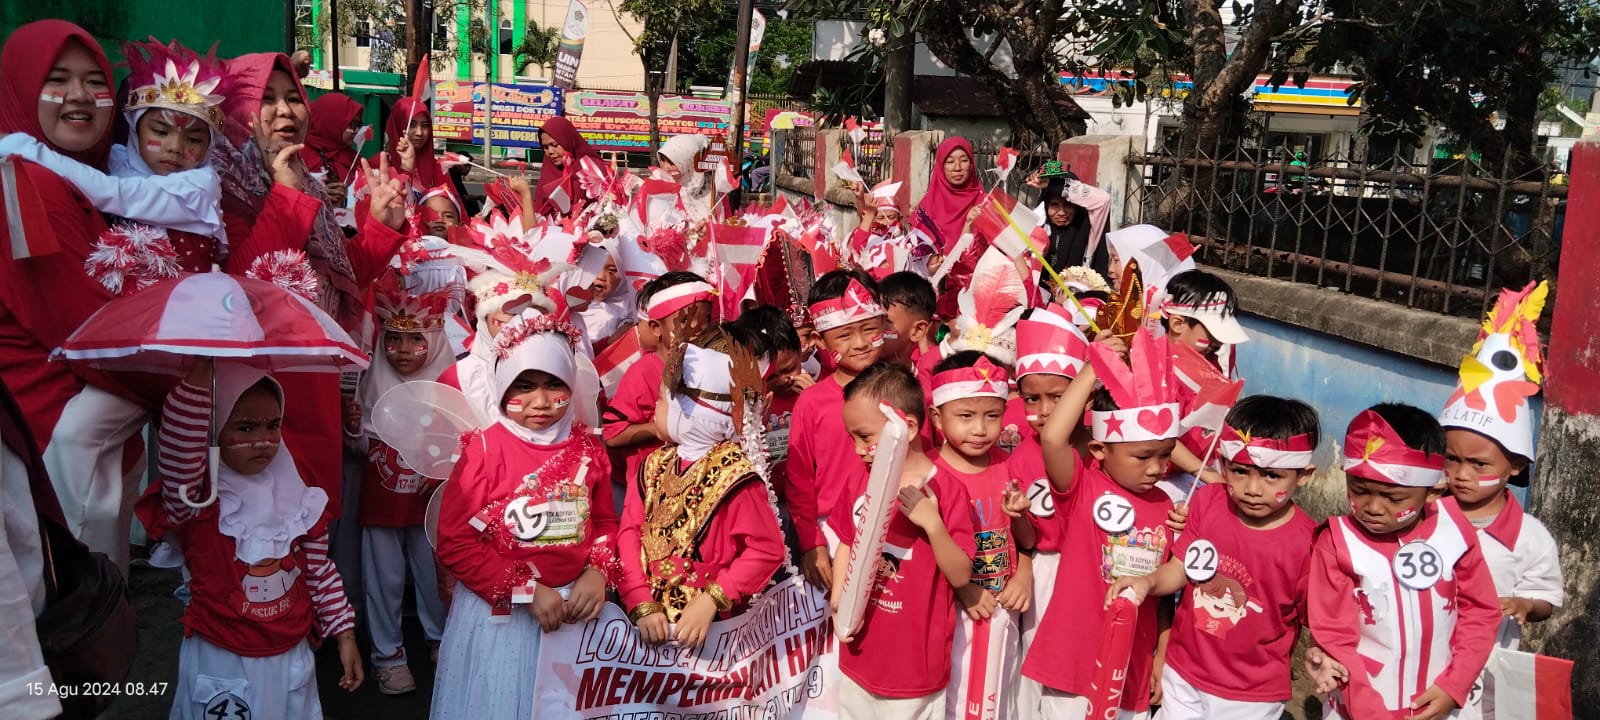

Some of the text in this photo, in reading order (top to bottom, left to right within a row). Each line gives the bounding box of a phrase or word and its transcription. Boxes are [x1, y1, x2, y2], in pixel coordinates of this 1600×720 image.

[558, 51, 579, 67] UIN
[516, 106, 557, 115] DOKTOR
[581, 98, 730, 114] SELAMAT SUKSES
[657, 119, 694, 127] DOKTOR
[1453, 410, 1494, 427] LATIF
[1097, 501, 1132, 525] 67
[842, 493, 872, 593] INDONESIA
[1187, 546, 1215, 570] 22
[1398, 551, 1438, 579] 38
[576, 617, 703, 671] LOMBA
[575, 644, 781, 711] MEMPERINGATI
[207, 699, 249, 720] 43
